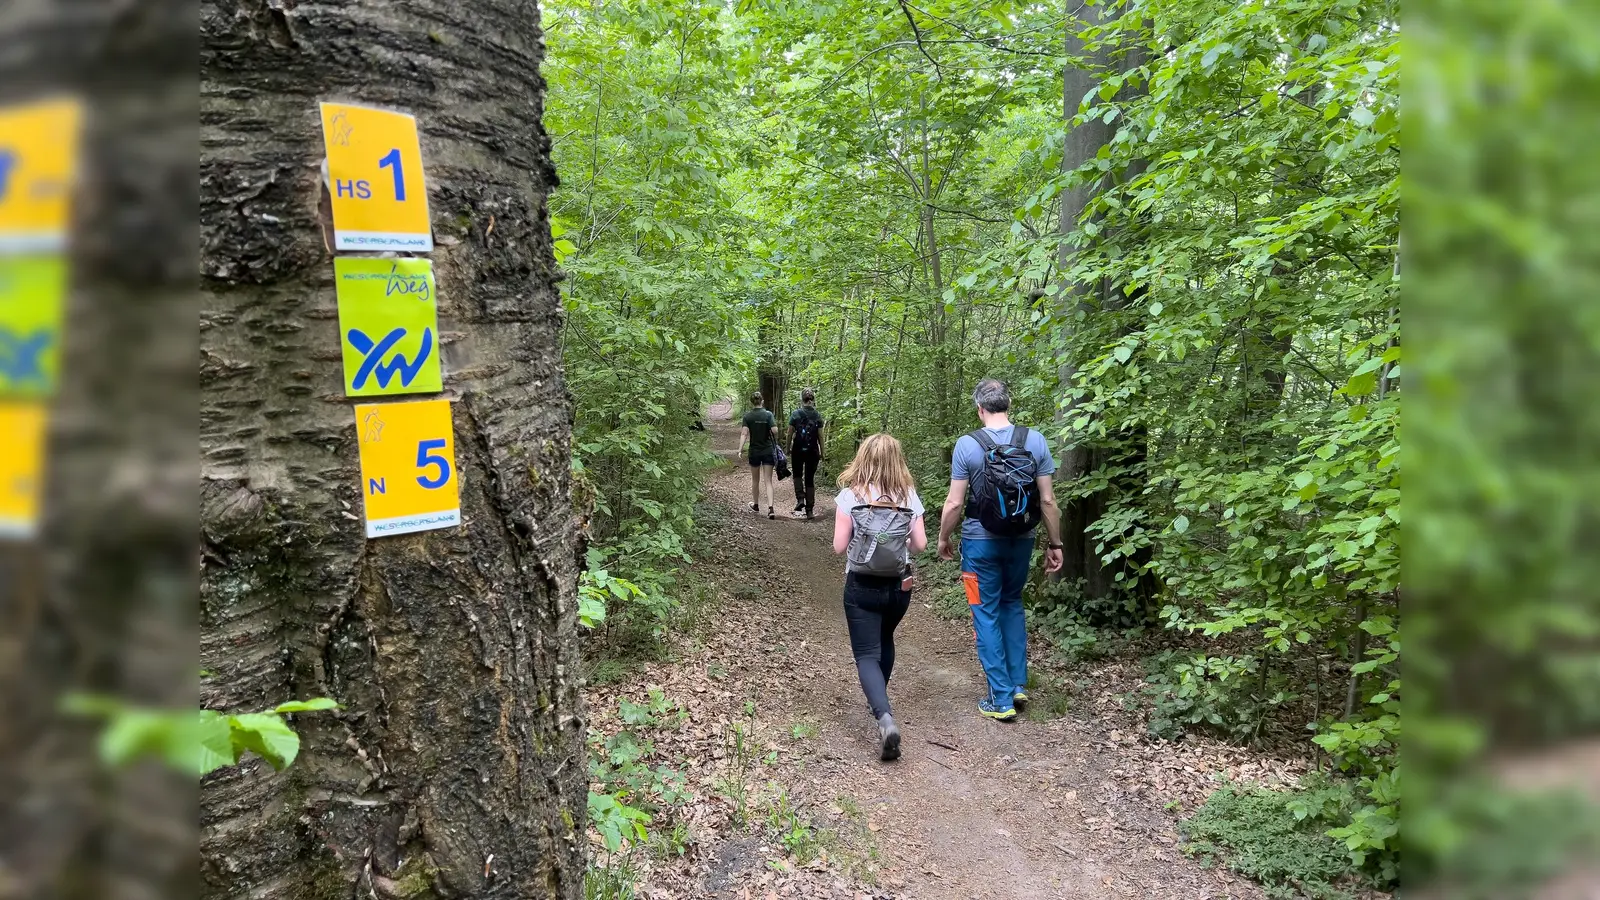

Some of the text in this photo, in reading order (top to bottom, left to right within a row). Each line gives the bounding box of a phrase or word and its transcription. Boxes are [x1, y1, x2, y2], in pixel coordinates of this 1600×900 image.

[336, 148, 406, 201] HS 1
[386, 264, 430, 301] Weg
[369, 438, 451, 495] N 5
